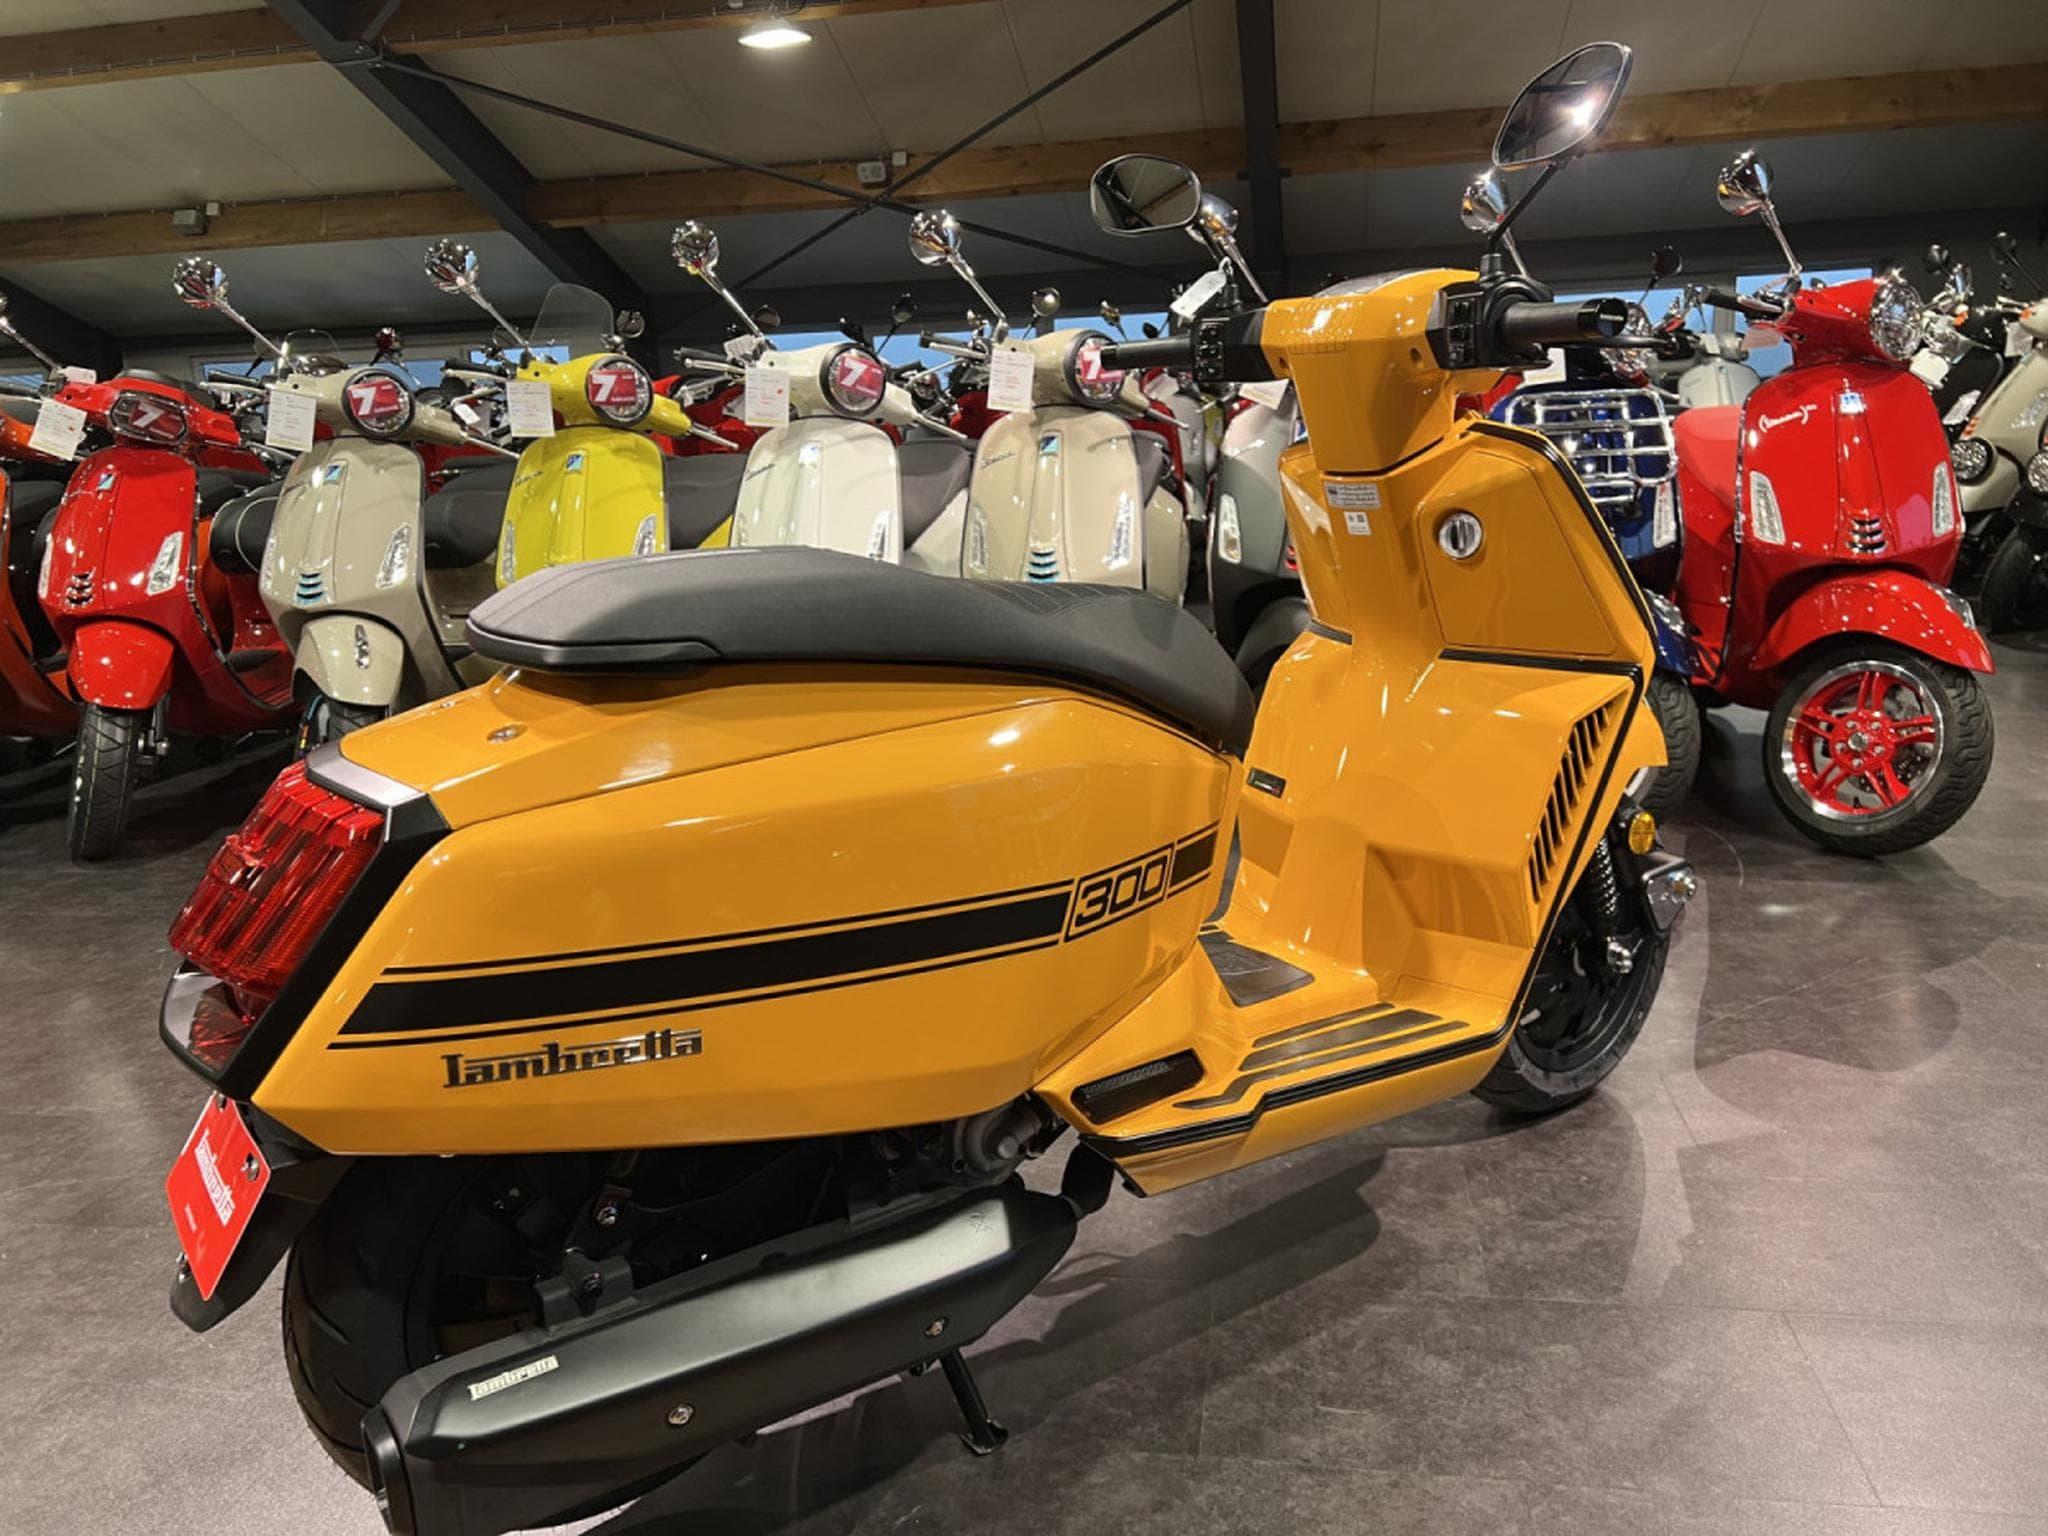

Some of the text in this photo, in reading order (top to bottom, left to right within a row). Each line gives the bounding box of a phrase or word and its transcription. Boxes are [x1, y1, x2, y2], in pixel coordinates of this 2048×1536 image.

[840, 356, 868, 389] 7
[1082, 350, 1101, 380] 7
[351, 386, 377, 416] 7
[592, 373, 618, 402] 7
[132, 402, 165, 429] 7
[1074, 854, 1169, 928] 300
